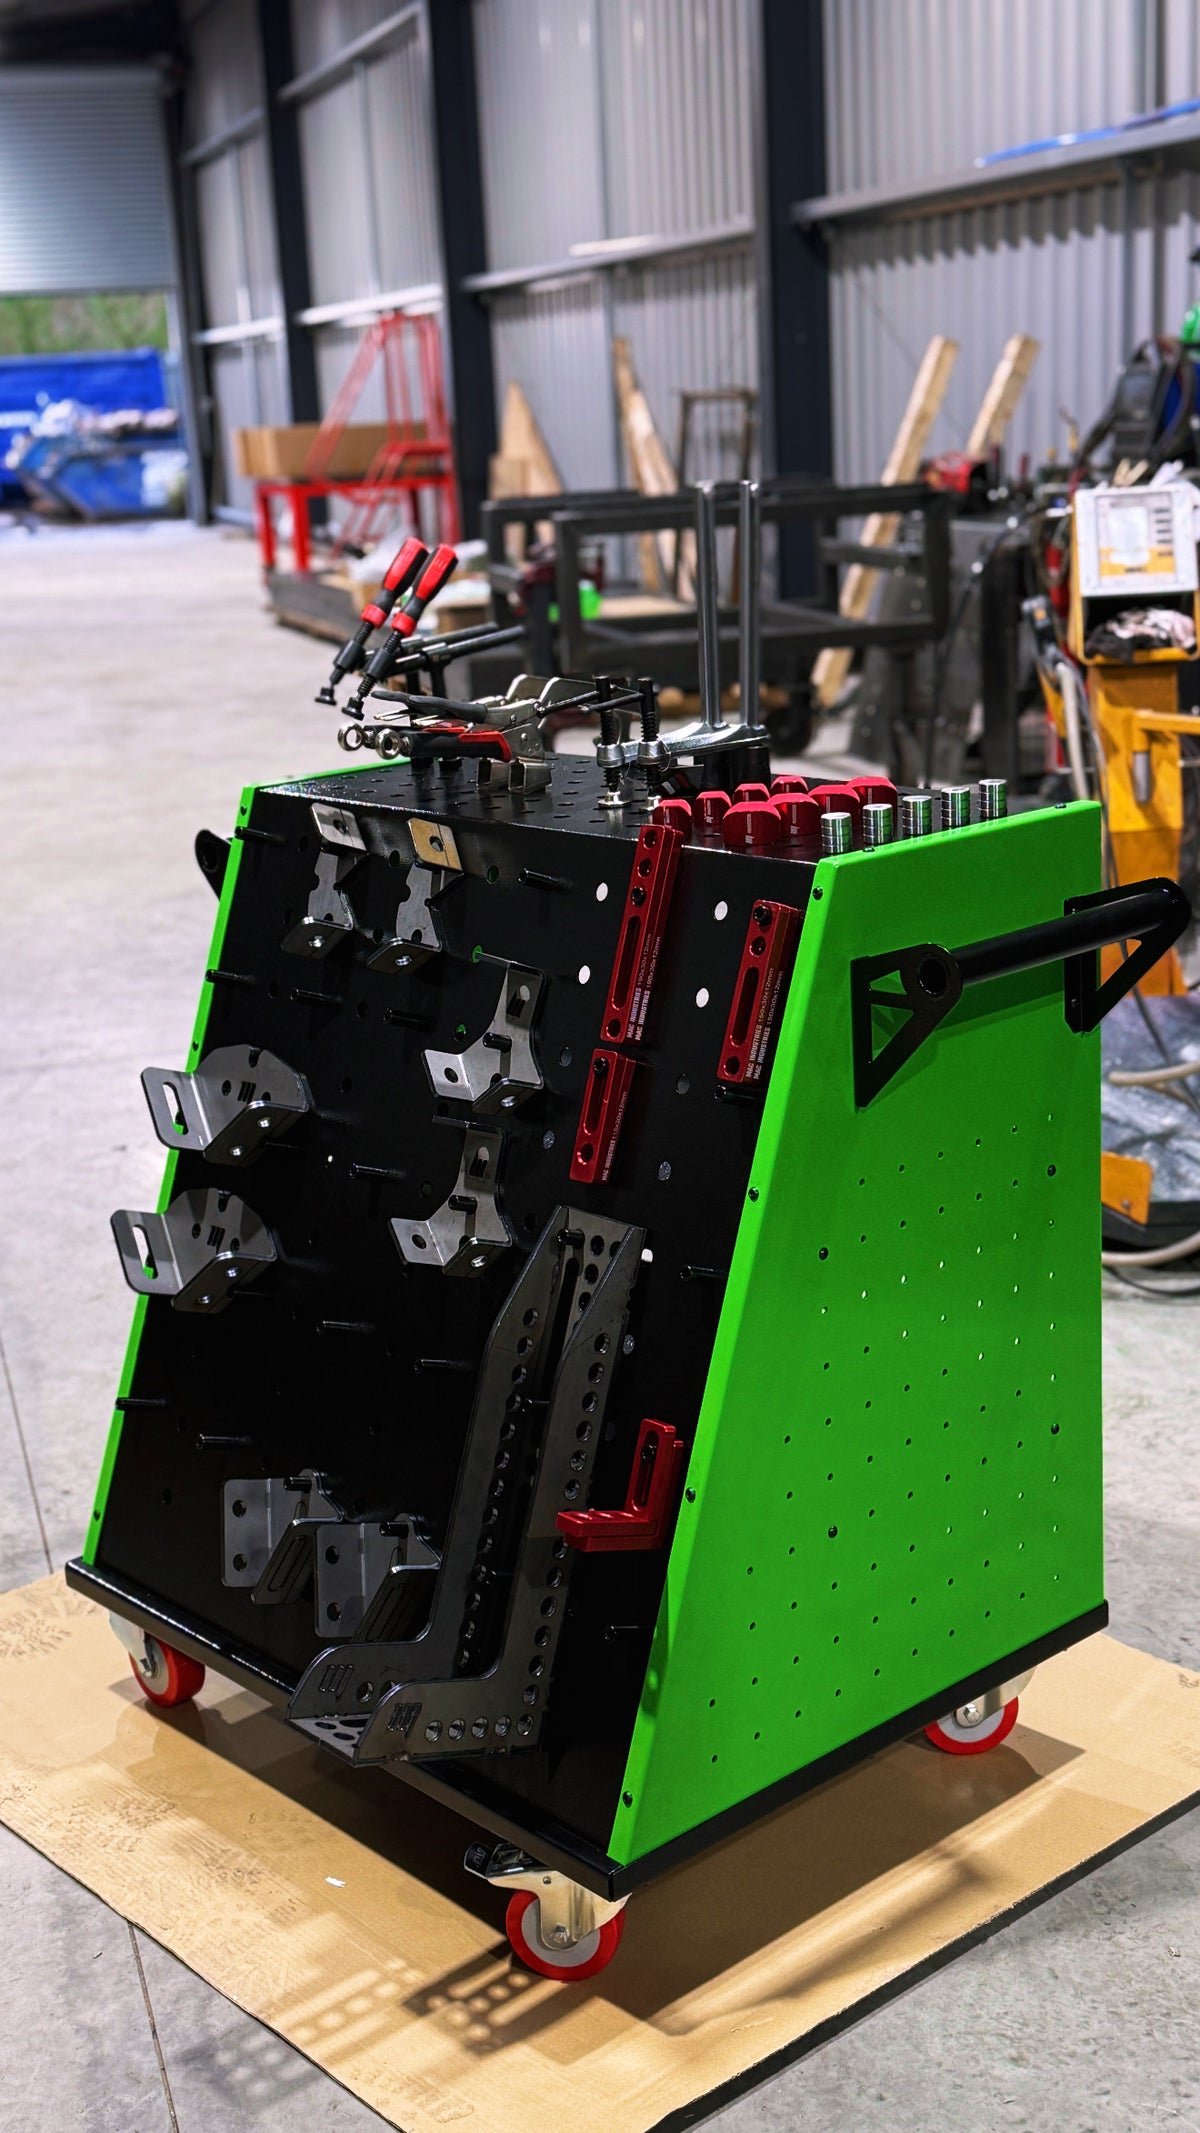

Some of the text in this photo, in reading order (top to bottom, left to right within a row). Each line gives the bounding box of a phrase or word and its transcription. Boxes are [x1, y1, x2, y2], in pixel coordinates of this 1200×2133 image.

[630, 987, 642, 1022] INDUSTRIES
[637, 990, 650, 1025] INDUSTRIES
[626, 1024, 635, 1038] MAC
[634, 1026, 643, 1040] MAC
[749, 1024, 762, 1061] INDUSTRIES
[757, 1027, 770, 1063] INDUSTRIES
[745, 1062, 754, 1077] MAC
[753, 1064, 762, 1079] MAC
